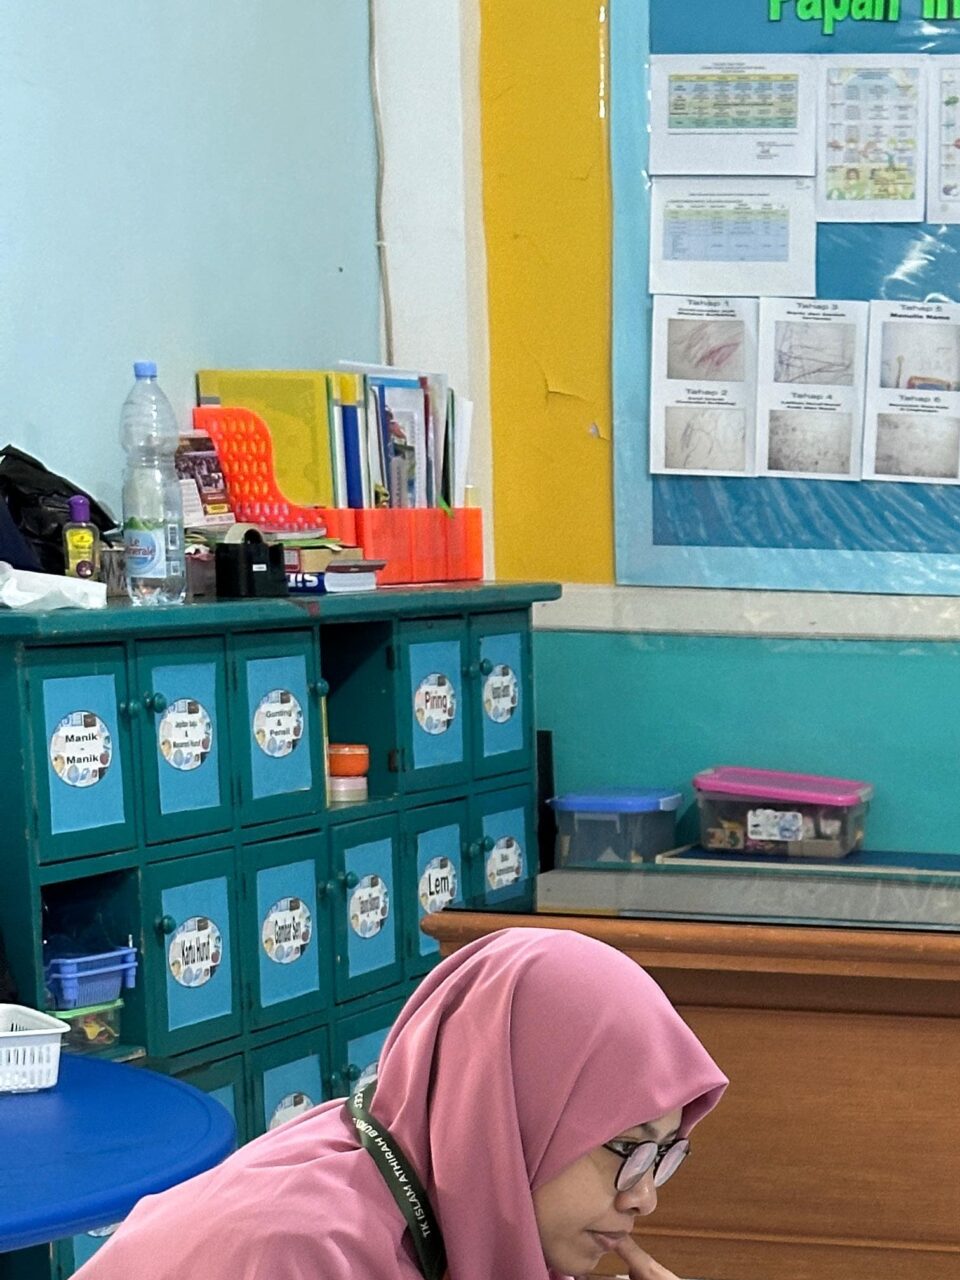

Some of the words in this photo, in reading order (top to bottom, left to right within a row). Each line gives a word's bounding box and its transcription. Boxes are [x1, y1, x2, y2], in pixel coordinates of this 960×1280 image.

[425, 690, 448, 713] Piring
[265, 710, 292, 718] Gunting
[65, 734, 98, 743] Manik
[270, 727, 291, 736] Pensil
[66, 755, 99, 764] Manik
[428, 873, 450, 896] Lem
[181, 939, 195, 966] Kartu
[196, 934, 211, 962] Huruf
[374, 1136, 408, 1182] ATHIRAH
[403, 1186, 427, 1220] ISLAM
[419, 1221, 431, 1238] TK
